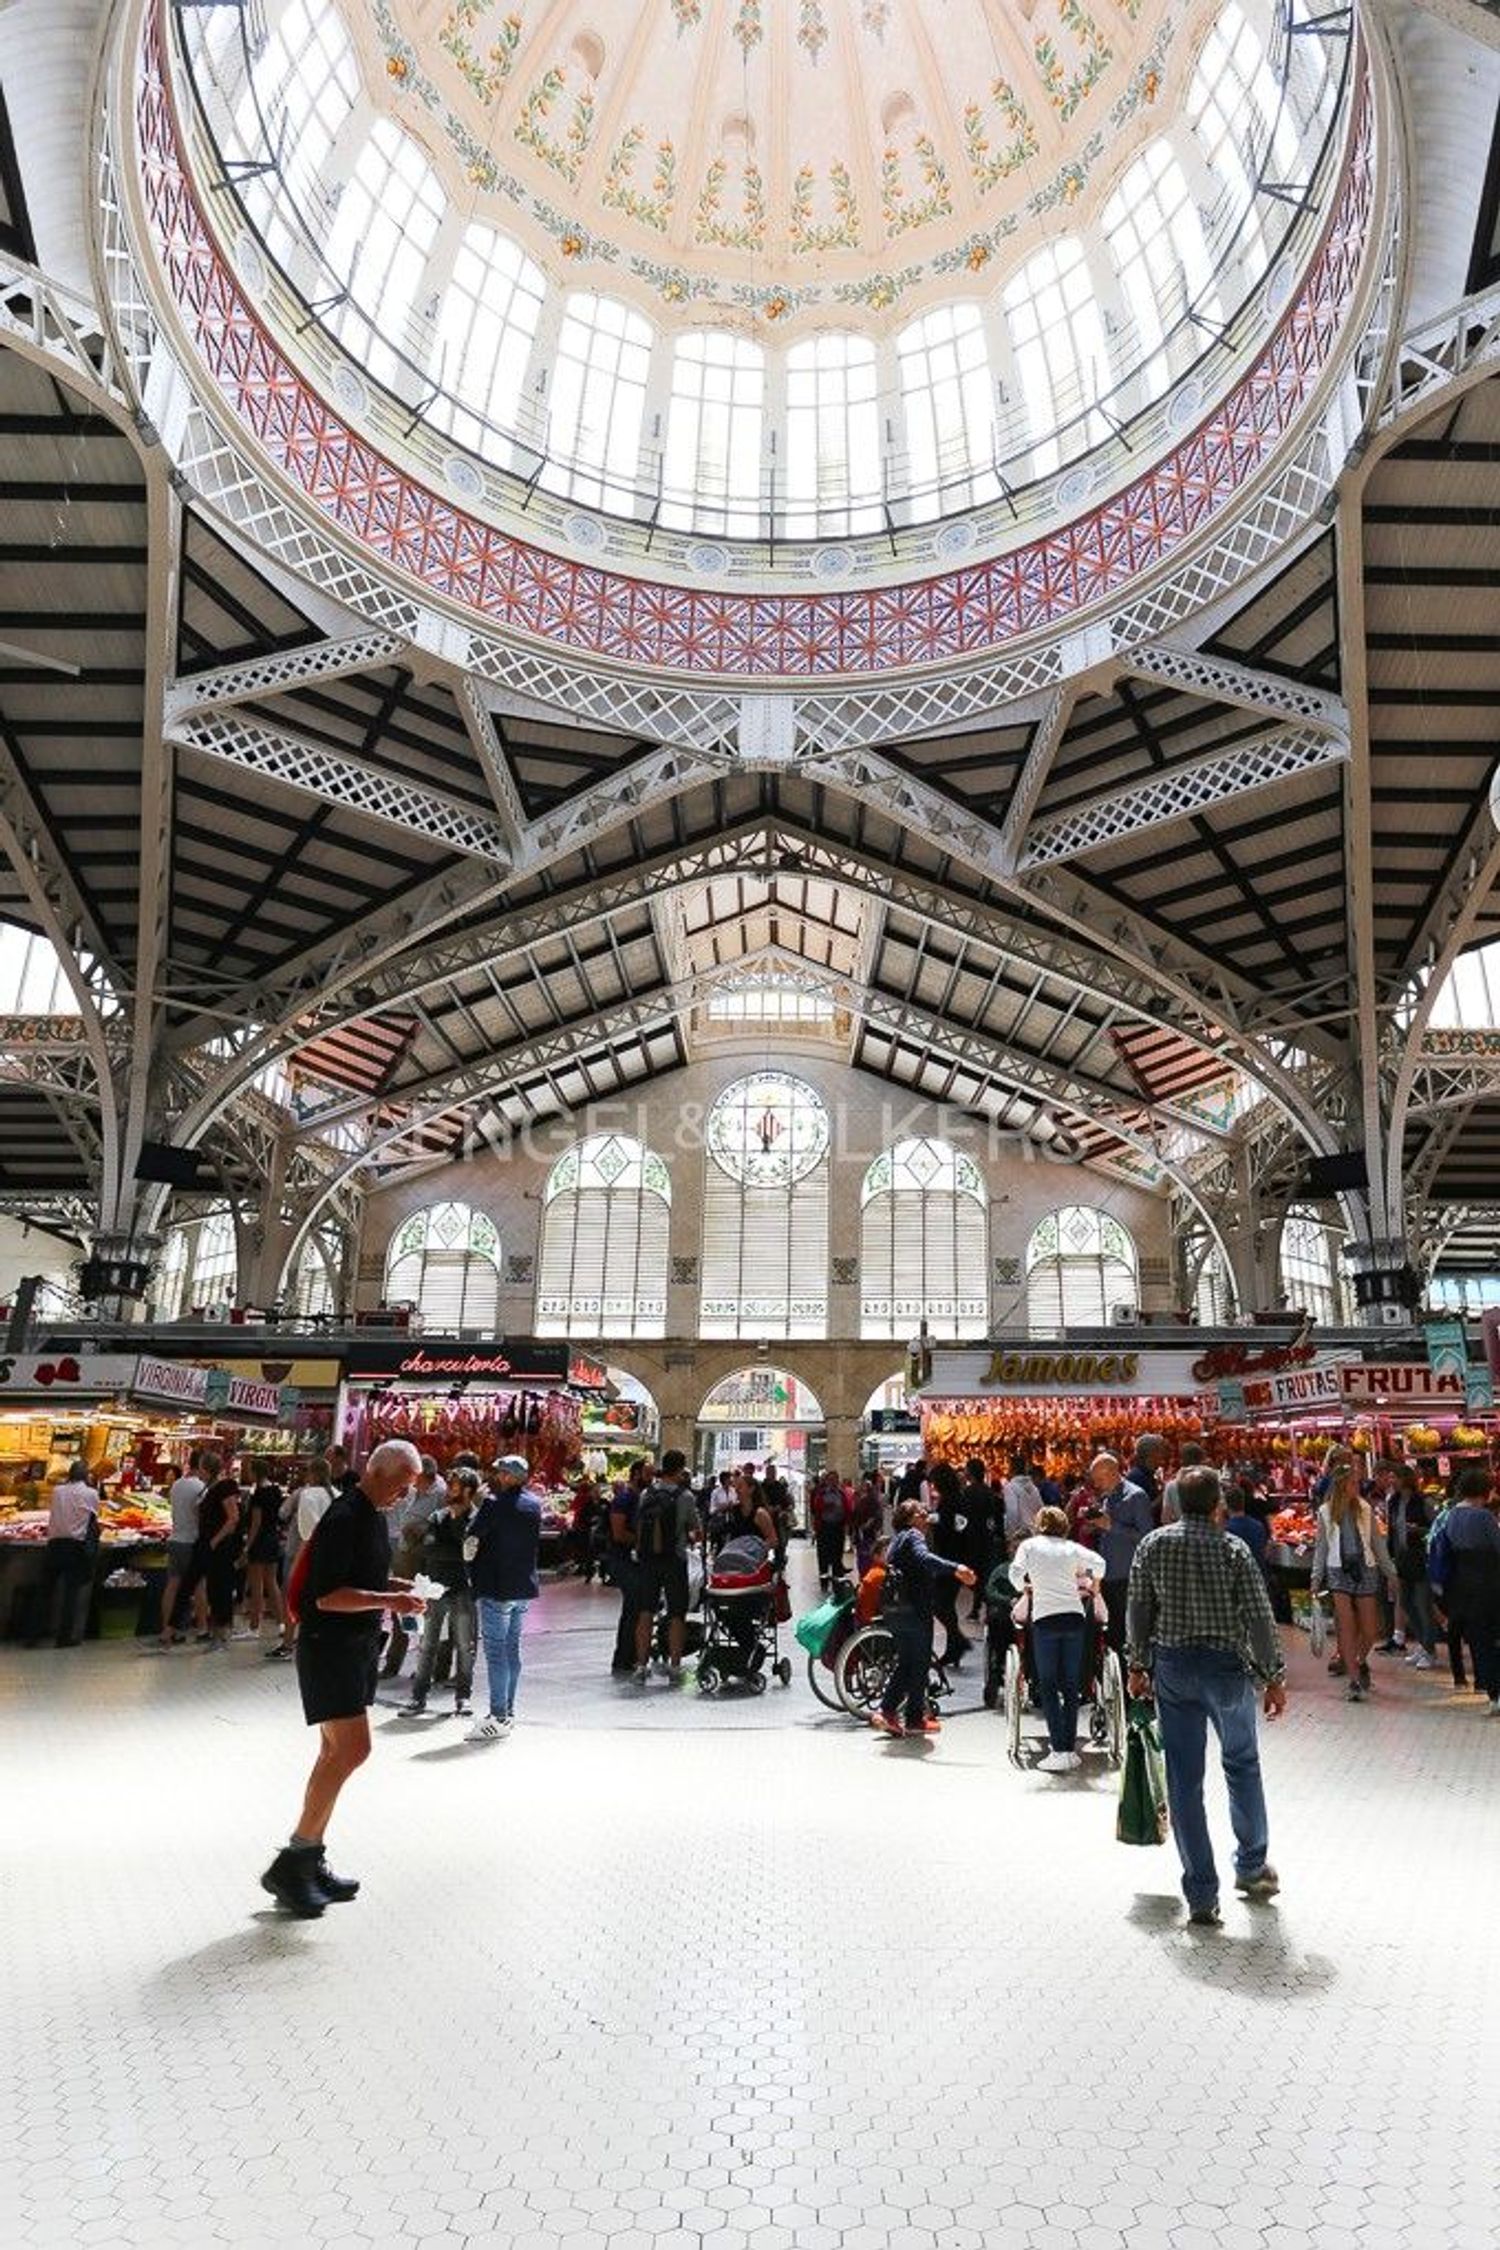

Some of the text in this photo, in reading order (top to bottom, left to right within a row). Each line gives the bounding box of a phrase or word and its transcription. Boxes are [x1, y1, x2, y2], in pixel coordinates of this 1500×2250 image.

[139, 1361, 194, 1396] VIRGINIA
[980, 1350, 1139, 1384] Jamones
[1342, 1367, 1465, 1394] FRUTA
[229, 1381, 278, 1410] VIRGIN
[1275, 1369, 1337, 1402] FRUTAS
